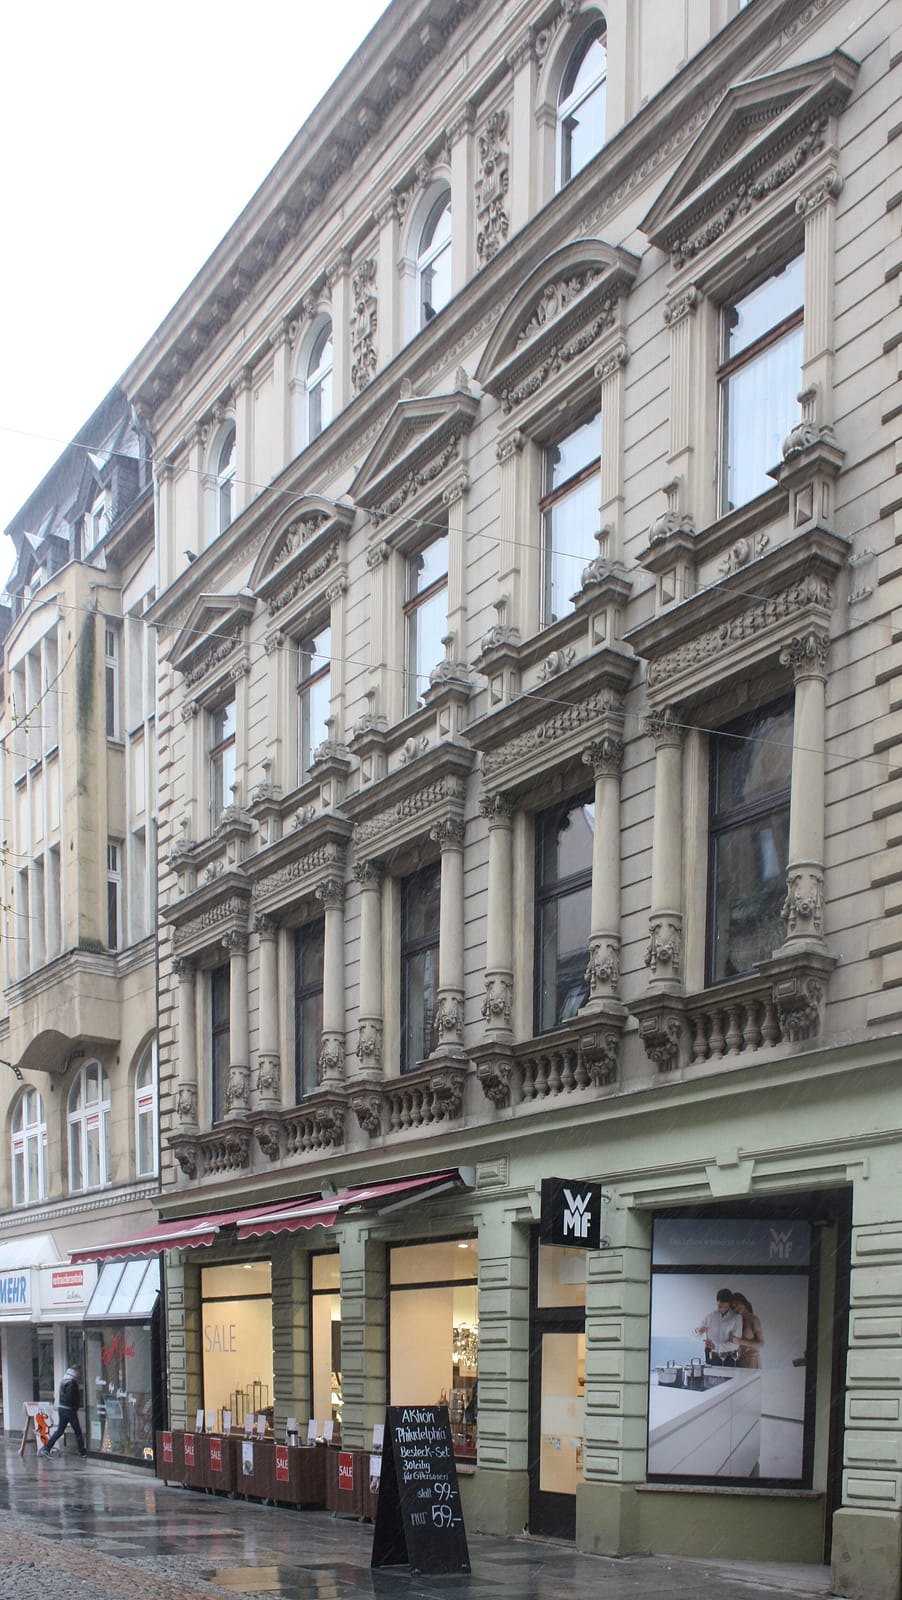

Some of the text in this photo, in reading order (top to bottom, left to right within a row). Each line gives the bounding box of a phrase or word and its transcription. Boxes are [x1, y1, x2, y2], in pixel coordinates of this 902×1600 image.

[563, 1188, 592, 1237] WMF
[205, 1324, 236, 1352] SALE
[163, 1442, 172, 1451] SALE
[184, 1445, 194, 1456] SALE
[210, 1450, 221, 1461] SALE
[276, 1458, 289, 1470] SALE
[339, 1466, 353, 1477] SALE
